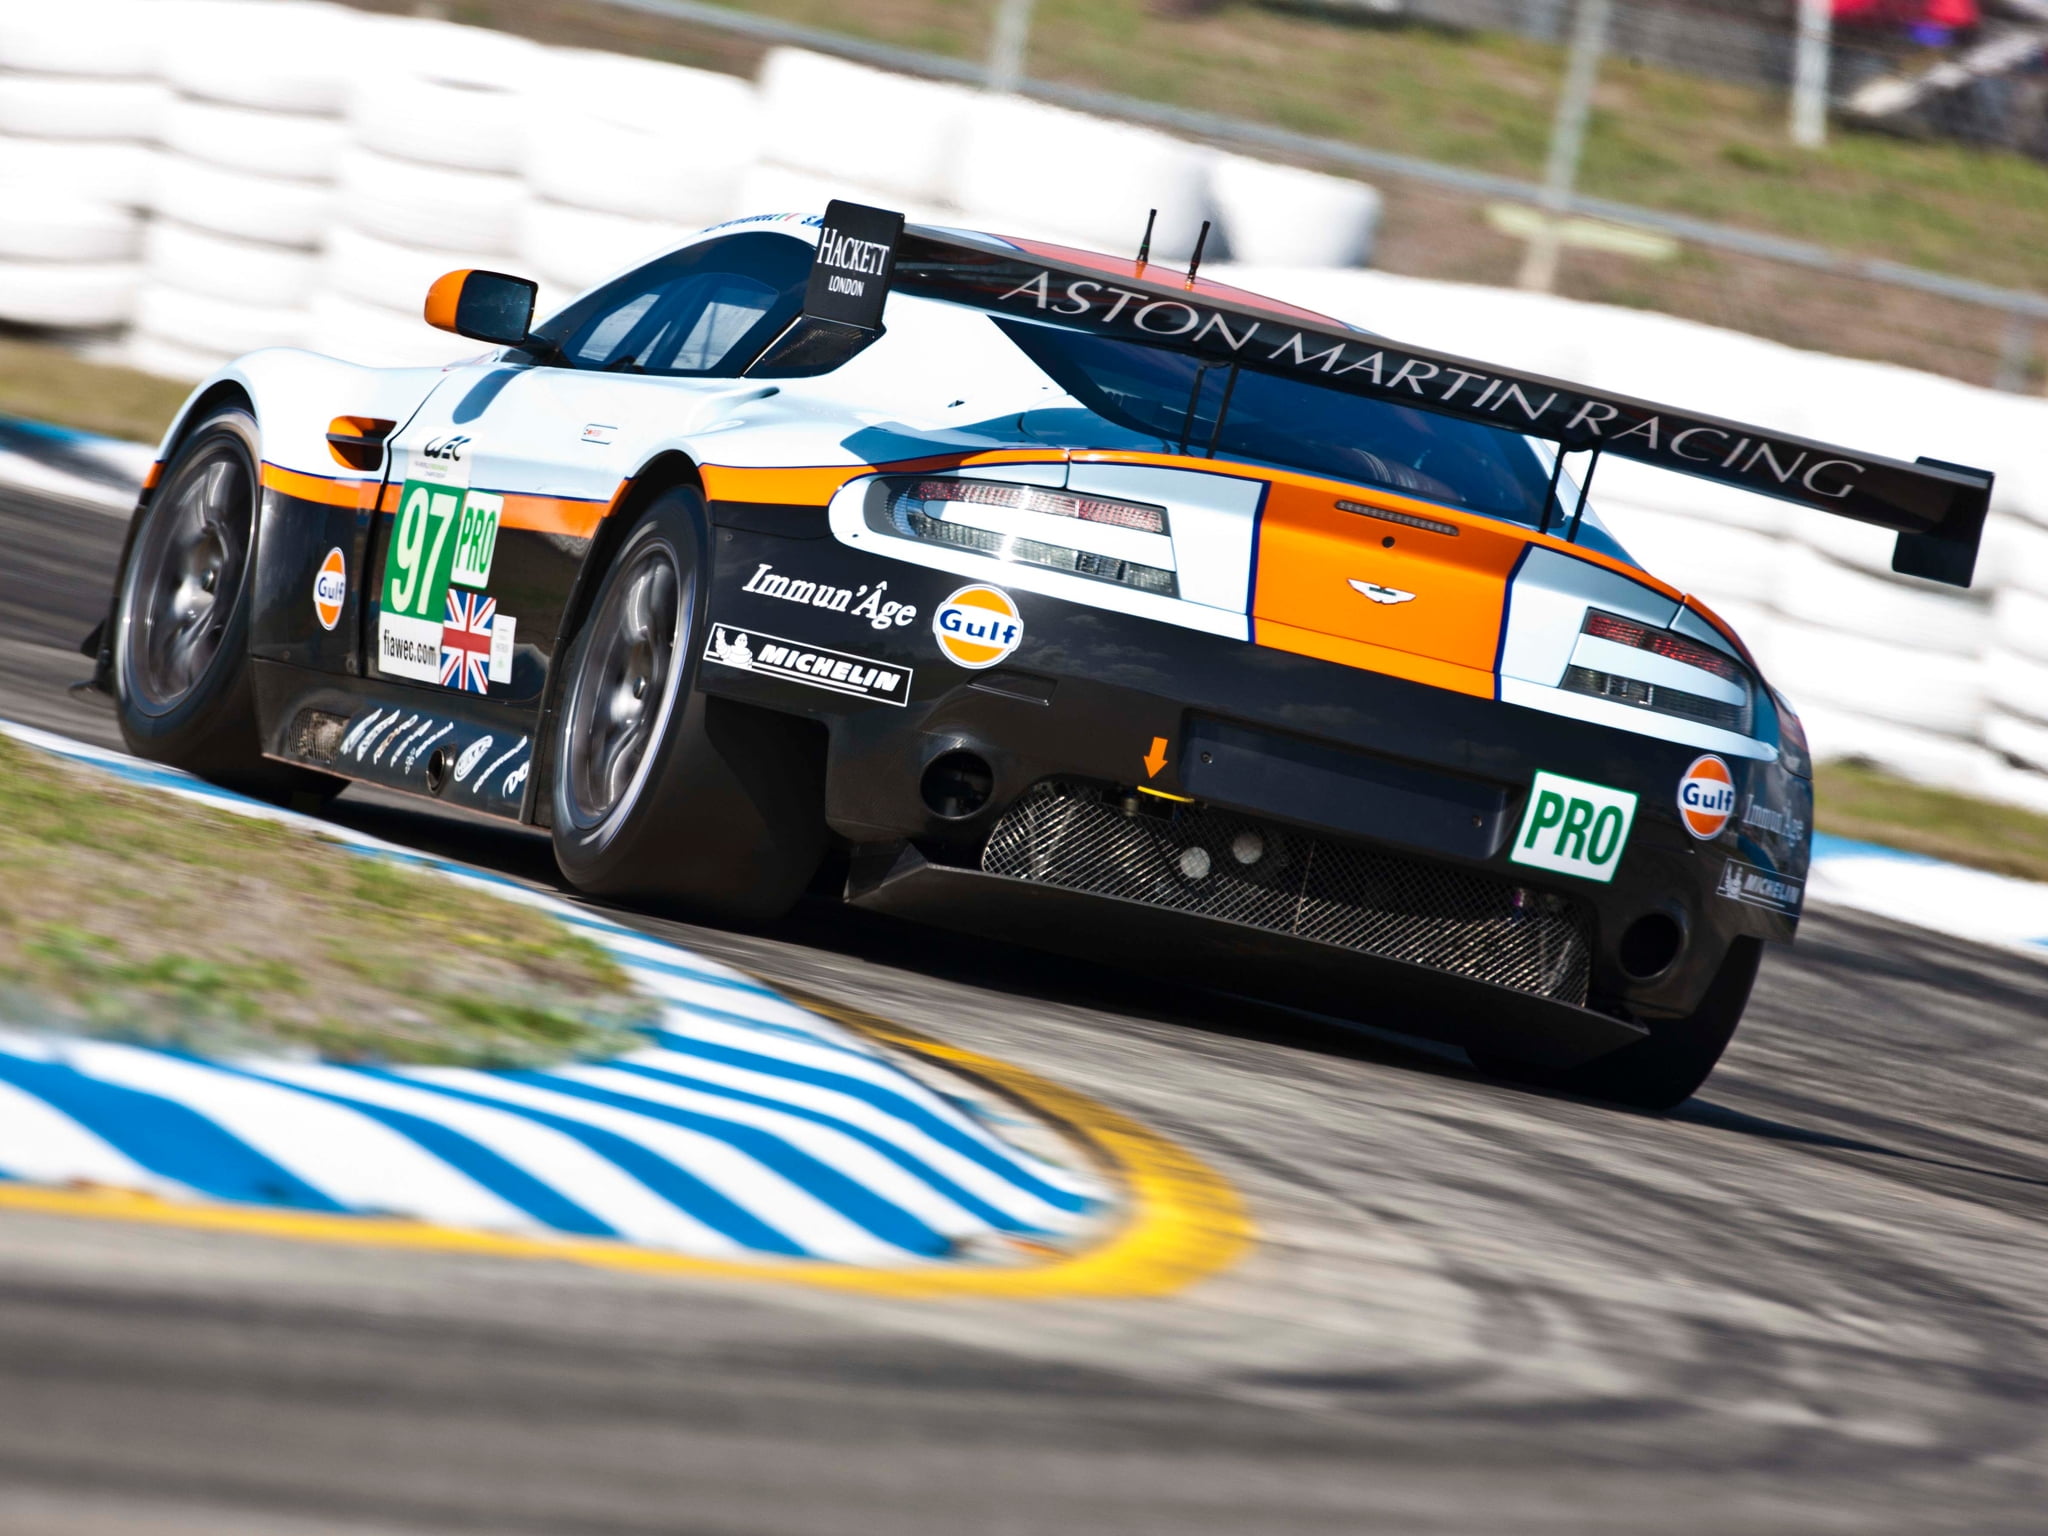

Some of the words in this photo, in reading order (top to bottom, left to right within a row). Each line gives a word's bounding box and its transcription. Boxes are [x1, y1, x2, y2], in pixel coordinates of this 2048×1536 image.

[817, 227, 890, 276] HACKETT
[828, 275, 864, 297] LONDON
[998, 272, 1261, 352] ASTON
[1268, 332, 1557, 422] MARTIN
[1566, 401, 1867, 499] RACING
[424, 435, 472, 461] WEC
[391, 487, 458, 615] 97
[456, 507, 497, 575] PRO
[317, 576, 345, 603] Gulf
[742, 563, 918, 630] Immun'Âge
[383, 633, 437, 667] fiawec.com
[939, 608, 1019, 645] Gulf
[756, 644, 902, 692] MICHELIN
[1682, 781, 1734, 812] Gulf
[1523, 790, 1624, 866] PRO
